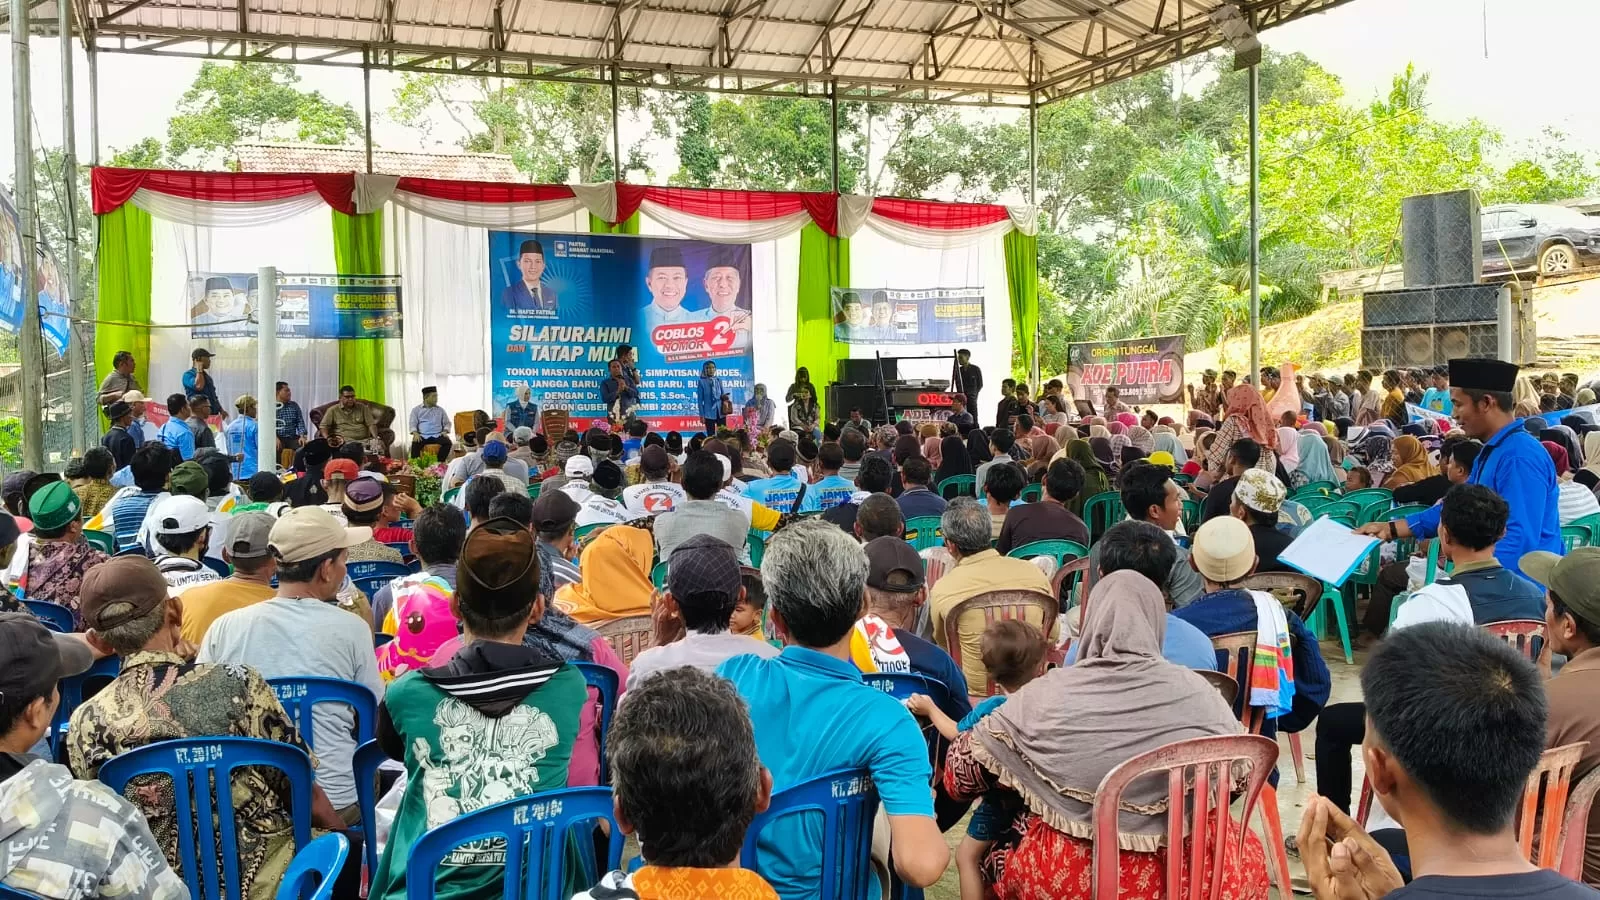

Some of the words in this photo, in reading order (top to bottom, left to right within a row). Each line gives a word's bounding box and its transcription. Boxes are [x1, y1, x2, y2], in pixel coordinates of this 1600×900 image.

[509, 325, 632, 343] SILATURAHMI
[655, 327, 705, 340] COBLOS
[711, 320, 732, 346] 2
[506, 344, 526, 352] DAN
[662, 339, 704, 353] NOMOR
[1091, 347, 1119, 358] ORGAN
[1120, 344, 1159, 355] TUNGGAL
[531, 346, 584, 362] TATAP
[587, 346, 639, 362] MUA
[506, 368, 539, 377] TOKOH
[541, 368, 607, 378] MASYARAKAT,
[1113, 358, 1173, 386] PUTRA
[502, 380, 529, 388] DESA
[531, 380, 569, 388] JANGGA
[571, 381, 600, 389] BARU,
[658, 381, 685, 389] BARU,
[722, 380, 746, 388] BARU
[544, 391, 584, 400] DENGAN
[586, 391, 600, 400] Dr.
[917, 393, 954, 406] ORG
[542, 403, 576, 411] CALON
[577, 404, 608, 412] GUBER
[637, 403, 659, 411] AMBI
[661, 403, 683, 411] 2024
[902, 409, 931, 421] ADE
[765, 491, 799, 503] JAMB
[176, 573, 199, 586] UNTUK
